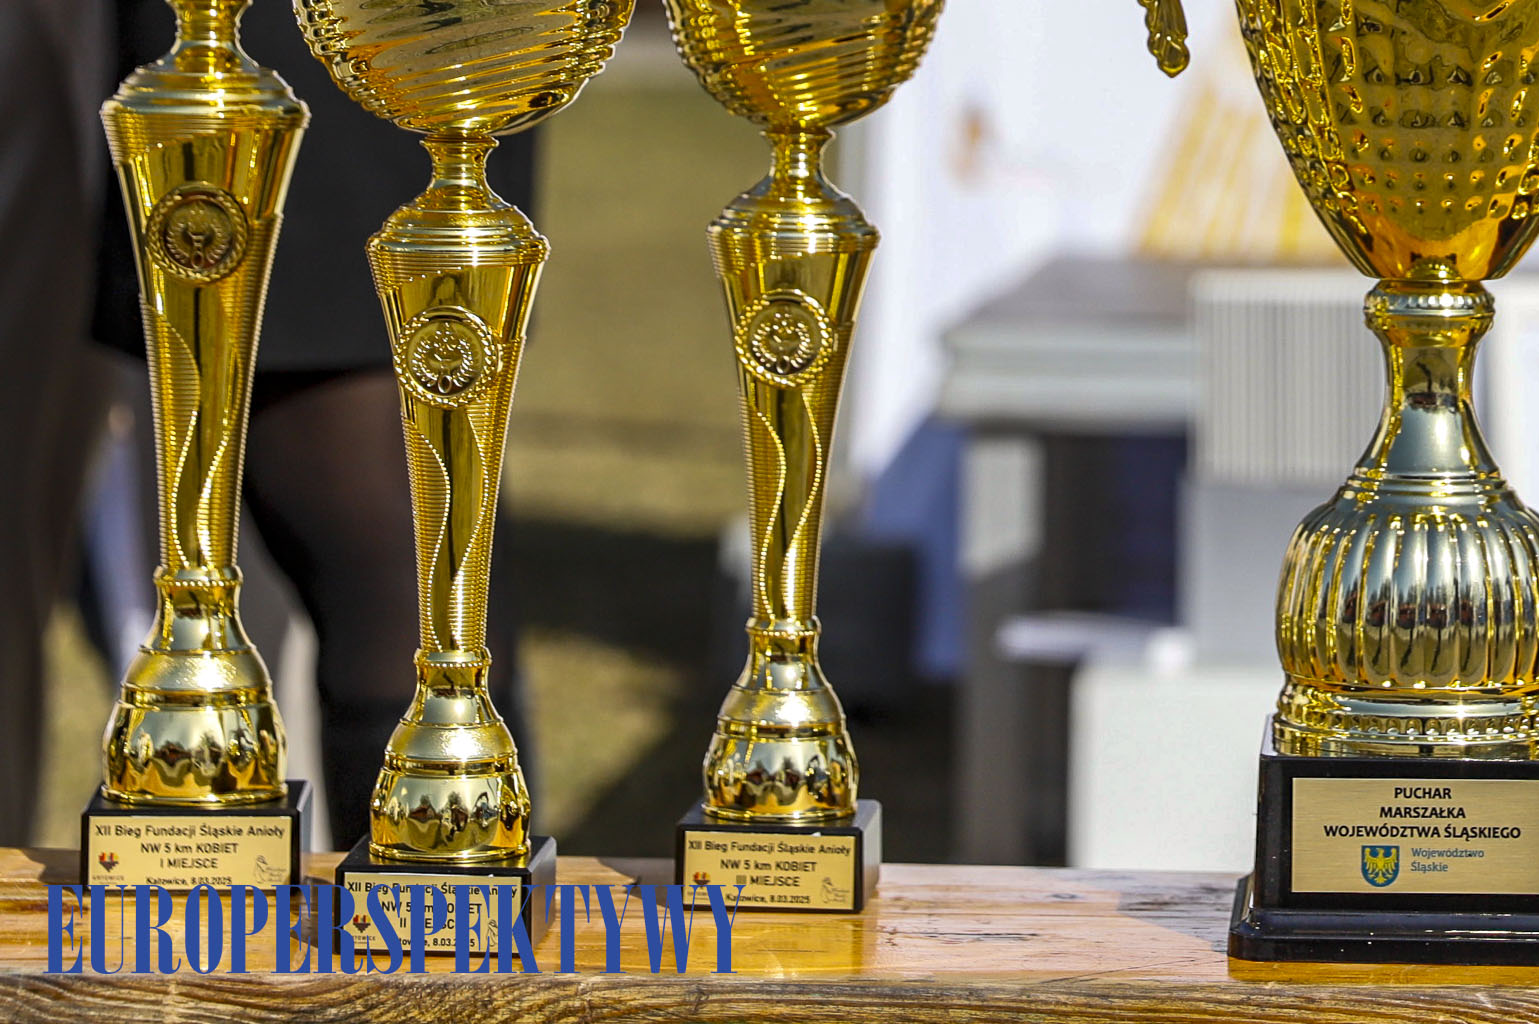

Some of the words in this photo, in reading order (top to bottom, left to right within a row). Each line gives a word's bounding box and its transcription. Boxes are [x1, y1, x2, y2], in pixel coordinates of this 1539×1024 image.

[1394, 787, 1452, 800] PUCHAR
[1379, 806, 1466, 819] MARSZAŁKA
[95, 825, 111, 836] XII
[115, 825, 141, 839] Bieg
[145, 825, 195, 839] Fundacji
[200, 822, 243, 838] Śląskie
[248, 825, 284, 839] Anioły
[1323, 823, 1440, 838] WOJEWÓDZTWA
[1444, 823, 1521, 842] ŚLĄSKIEGO
[140, 843, 161, 853] NW
[164, 843, 172, 853] 5
[175, 843, 192, 853] km
[197, 843, 238, 853] KOBIET
[705, 841, 727, 853] Bieg
[731, 842, 774, 854] Fundacji
[777, 841, 816, 855] Śląskie
[1411, 847, 1484, 860] Województwo
[167, 858, 218, 869] MIEJSCE
[720, 859, 741, 869] NW
[743, 860, 751, 870] 5
[754, 860, 771, 871] km
[775, 861, 817, 872] KOBIET
[1410, 860, 1448, 874] Śląskie
[348, 882, 361, 892] XII
[750, 876, 800, 887] MIEJSCE
